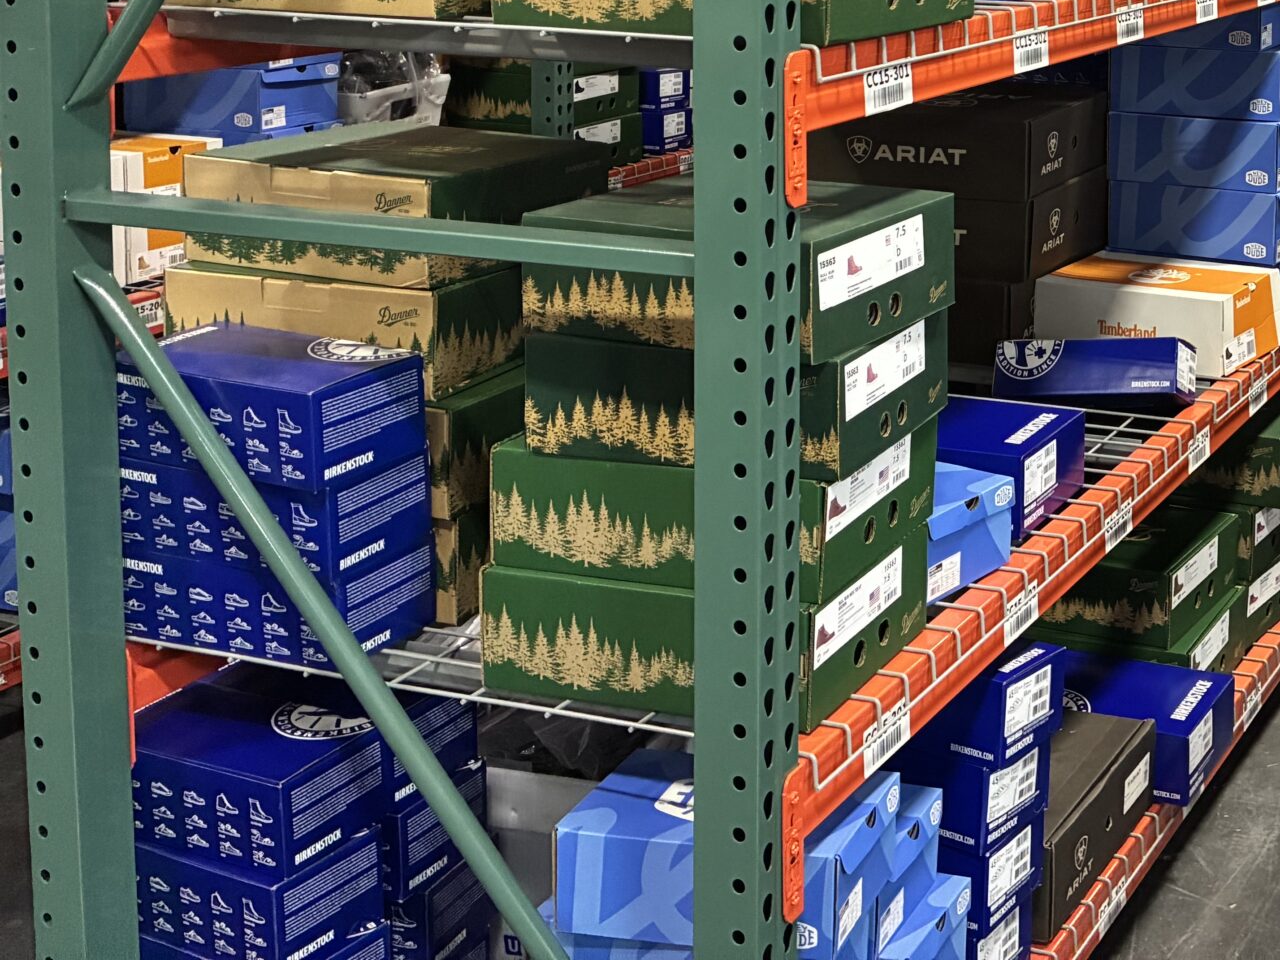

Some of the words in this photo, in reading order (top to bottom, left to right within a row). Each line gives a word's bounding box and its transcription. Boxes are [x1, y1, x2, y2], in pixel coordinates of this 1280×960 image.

[866, 63, 910, 89] CC15-301
[1250, 101, 1271, 113] DUDE
[873, 144, 967, 166] ARIAT
[1040, 157, 1063, 176] ARIAT
[1247, 173, 1268, 185] DUDE
[375, 192, 413, 213] Danner
[895, 225, 906, 239] 7.5
[1042, 233, 1065, 254] ARIAT
[1245, 246, 1267, 258] DUDE
[377, 305, 420, 327] Danner
[903, 331, 912, 345] 7.5
[1097, 320, 1157, 338] Timberland
[1032, 349, 1060, 375] SINCE
[1131, 380, 1170, 388] BIRKENSTOCK.COM
[324, 451, 374, 480] BIRKENSTOCK
[339, 539, 385, 571] BIRKENSTOCK
[1170, 679, 1213, 721] BIRKENSTOCK
[950, 743, 994, 761] BIRKENSTOCK.COM
[987, 816, 1019, 844] BIRKENSTOCK
[295, 828, 342, 866] BIRKENSTOCK
[408, 855, 449, 890] BIRKENSTOCK
[1066, 857, 1094, 901] ARIAT
